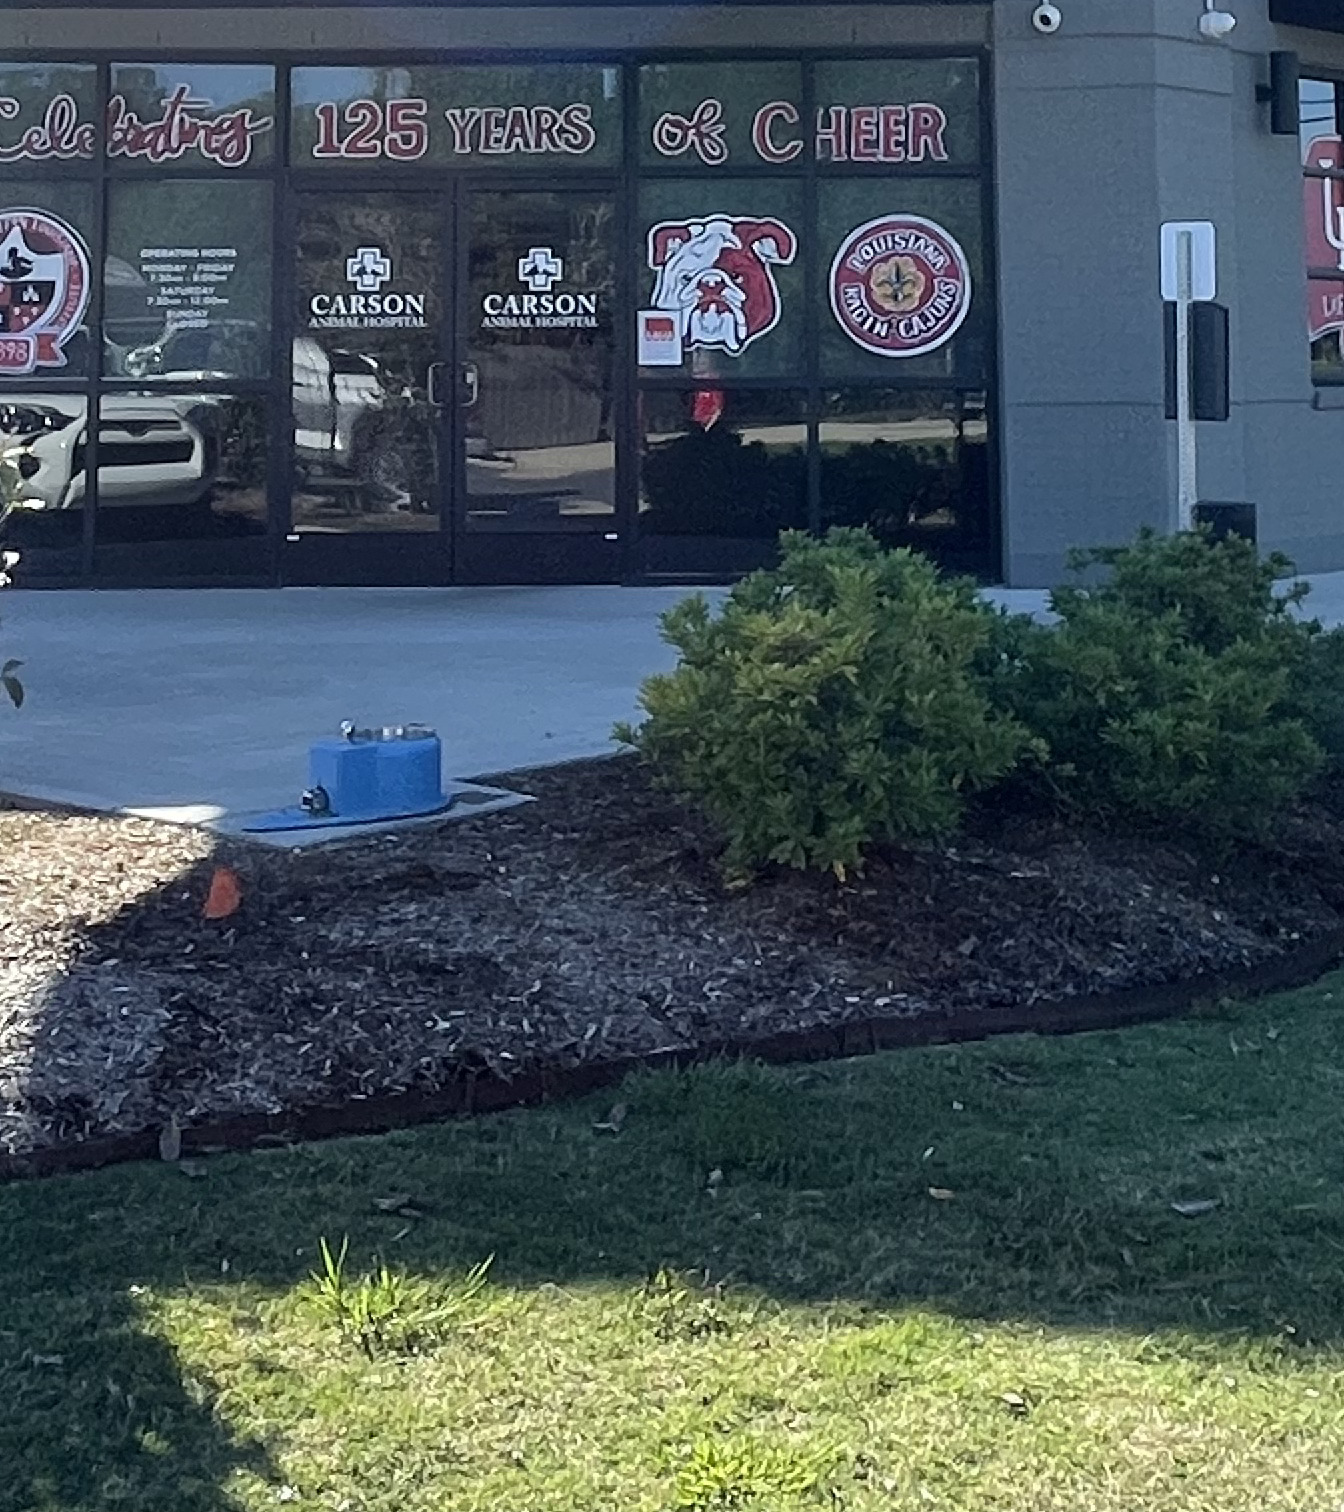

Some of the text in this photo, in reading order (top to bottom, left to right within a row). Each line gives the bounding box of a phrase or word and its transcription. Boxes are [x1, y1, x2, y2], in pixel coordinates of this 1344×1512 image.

[313, 99, 428, 160] 125
[445, 103, 596, 154] YEARS
[653, 99, 729, 165] of
[752, 100, 949, 163] CHEER
[849, 232, 946, 271] LOUISIANA
[310, 294, 425, 315] CARSON
[482, 294, 597, 315] CARSON
[898, 281, 957, 339] CAJUNS
[308, 316, 429, 328] ANIMAL HOSPITAL
[480, 316, 600, 328] ANIMAL HOSPITAL
